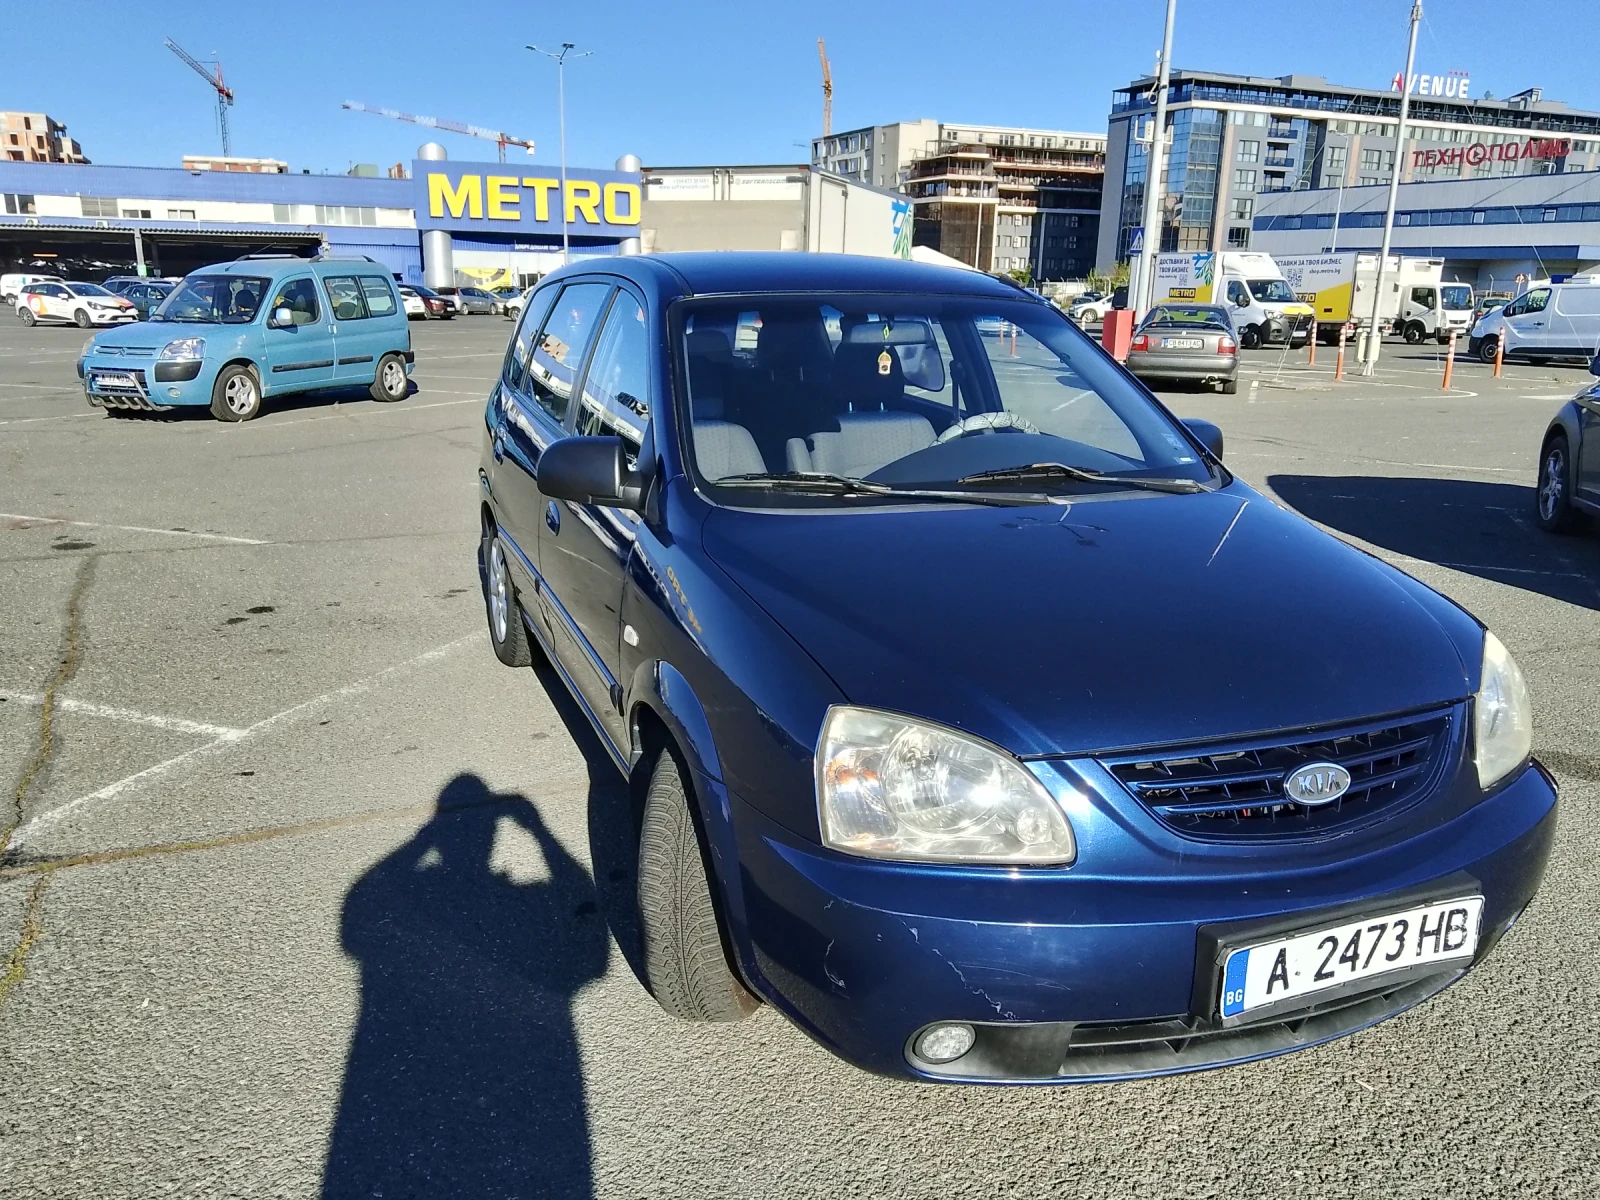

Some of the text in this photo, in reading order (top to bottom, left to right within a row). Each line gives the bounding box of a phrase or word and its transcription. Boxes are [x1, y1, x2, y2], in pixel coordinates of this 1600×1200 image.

[427, 173, 641, 226] METRO
[1170, 289, 1195, 297] METRO
[1297, 770, 1341, 796] KIA
[1266, 907, 1469, 996] A 2473 HB
[1226, 989, 1244, 1007] BG
